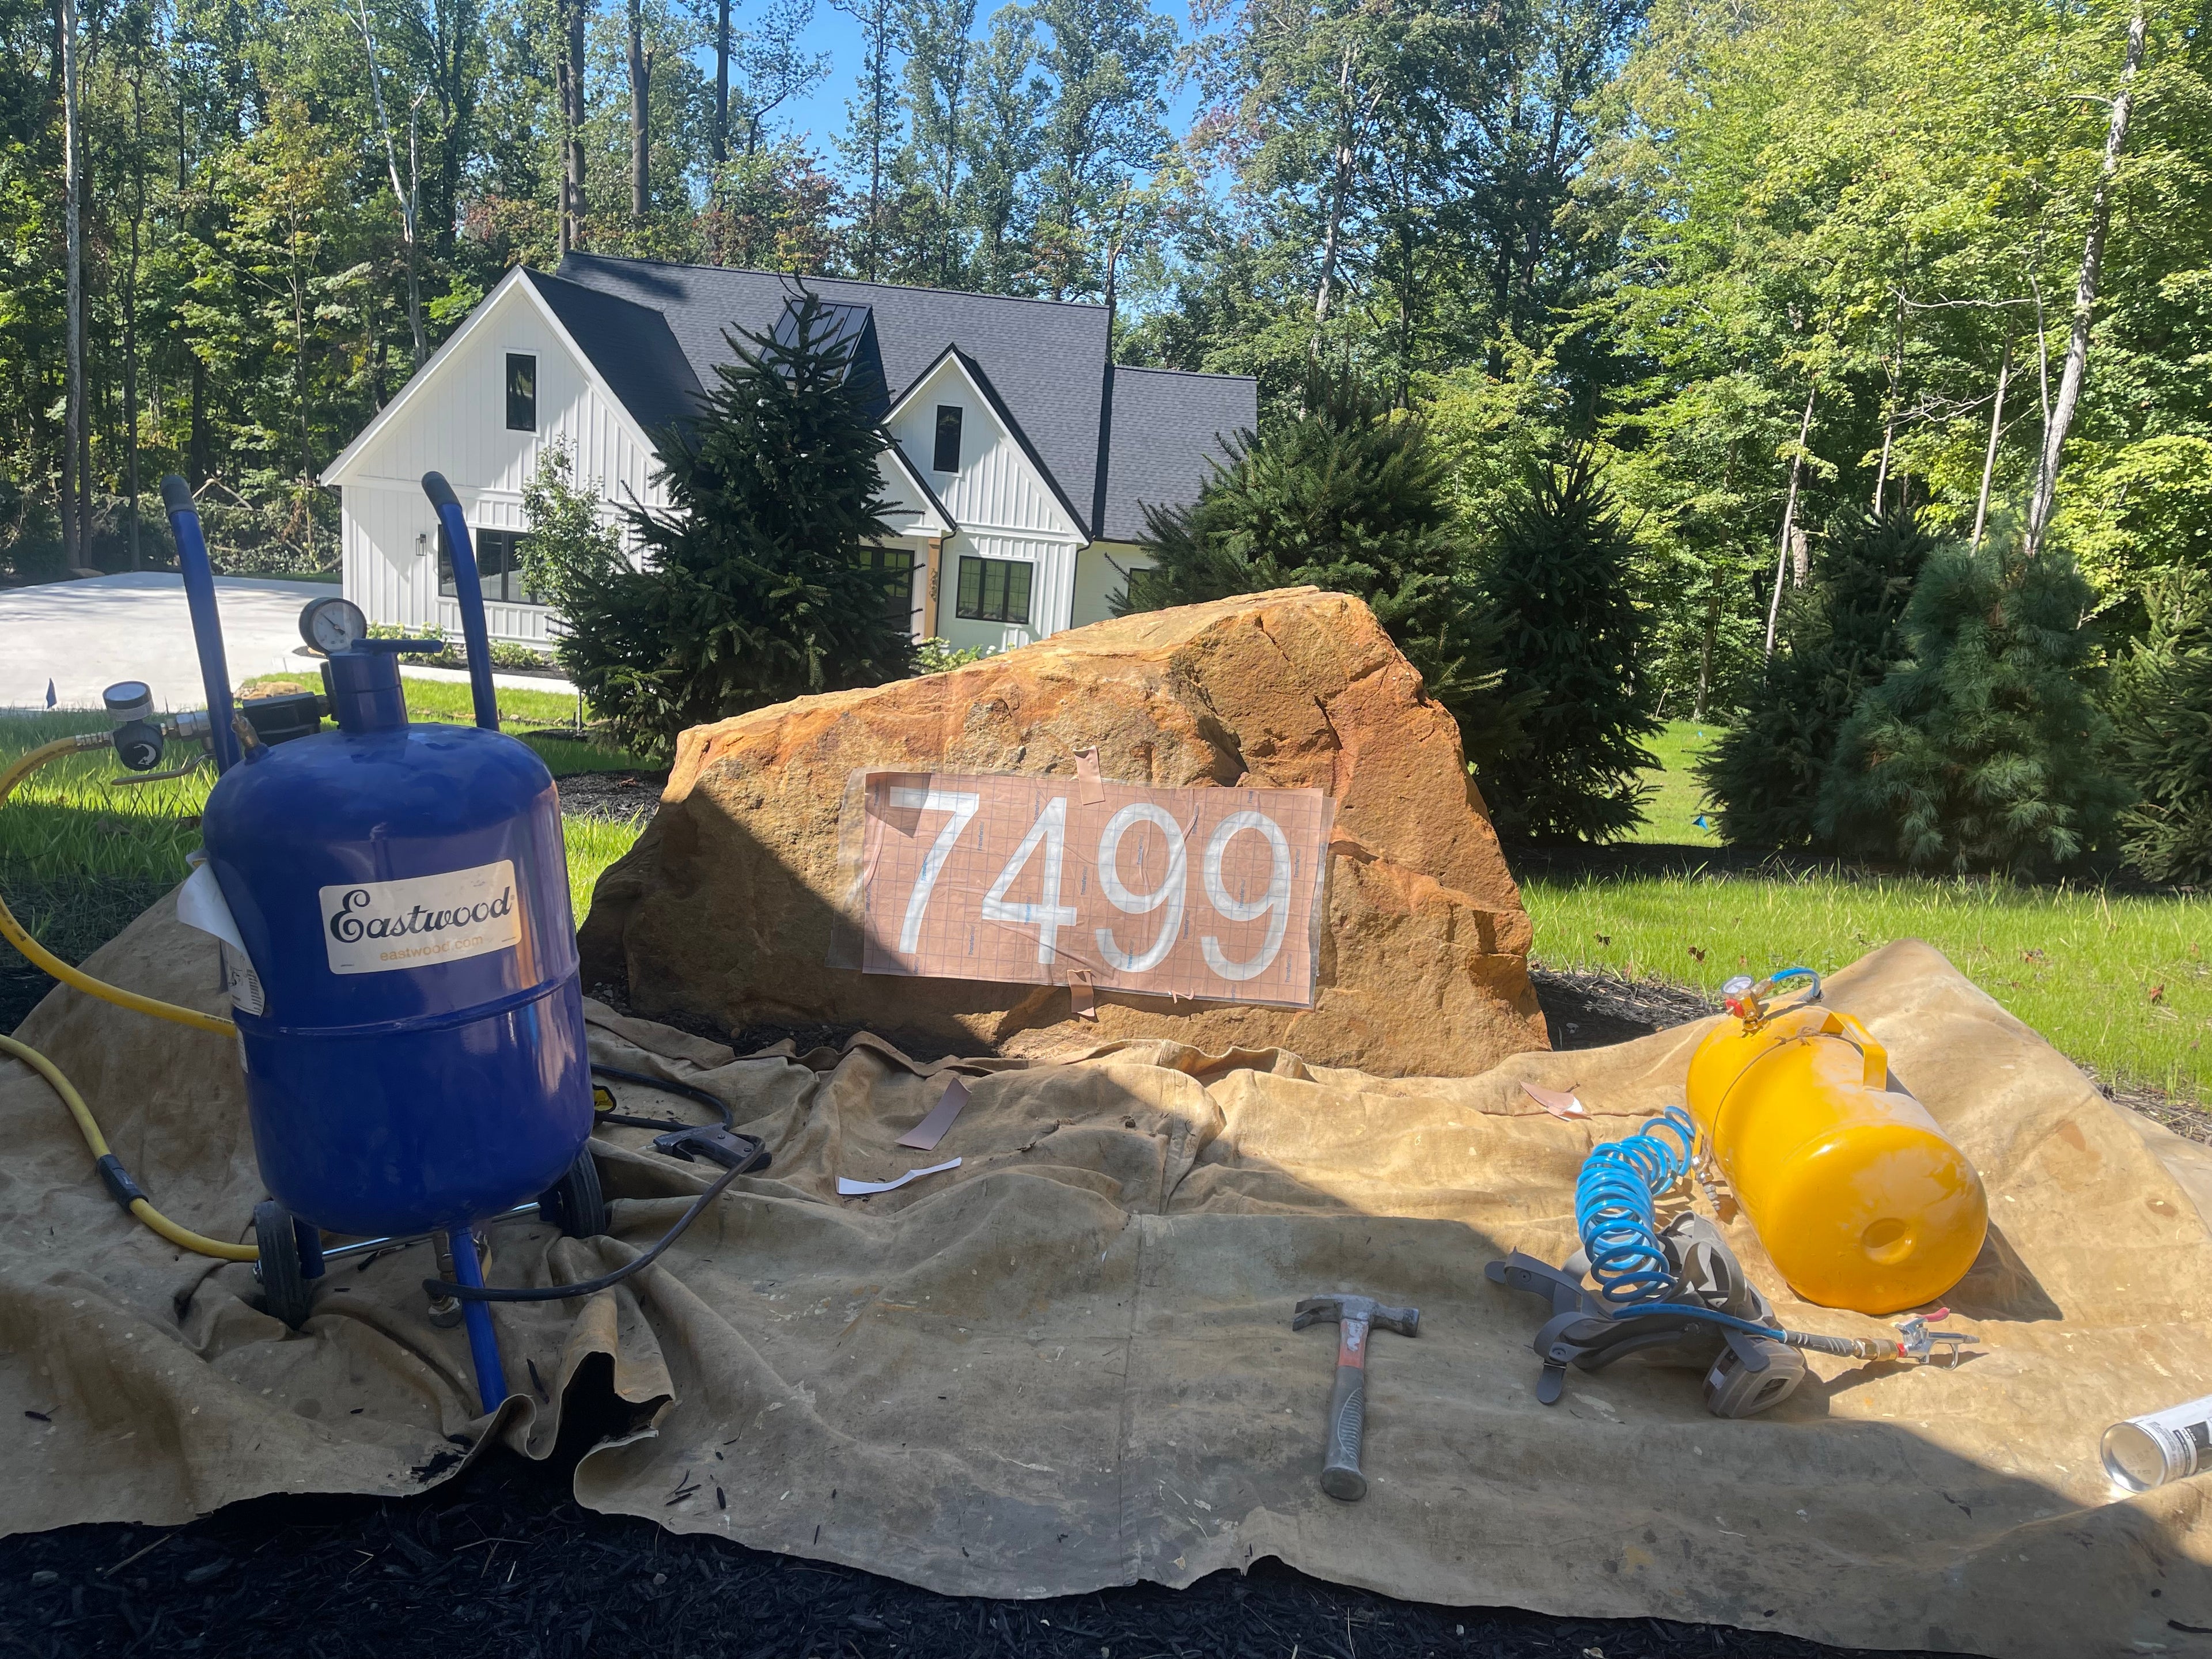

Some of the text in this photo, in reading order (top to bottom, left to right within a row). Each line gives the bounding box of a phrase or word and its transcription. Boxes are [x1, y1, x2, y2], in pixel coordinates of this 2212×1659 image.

[890, 786, 1291, 980] 7499
[330, 886, 512, 942] Eastwood
[380, 935, 483, 961] eastwood.com
